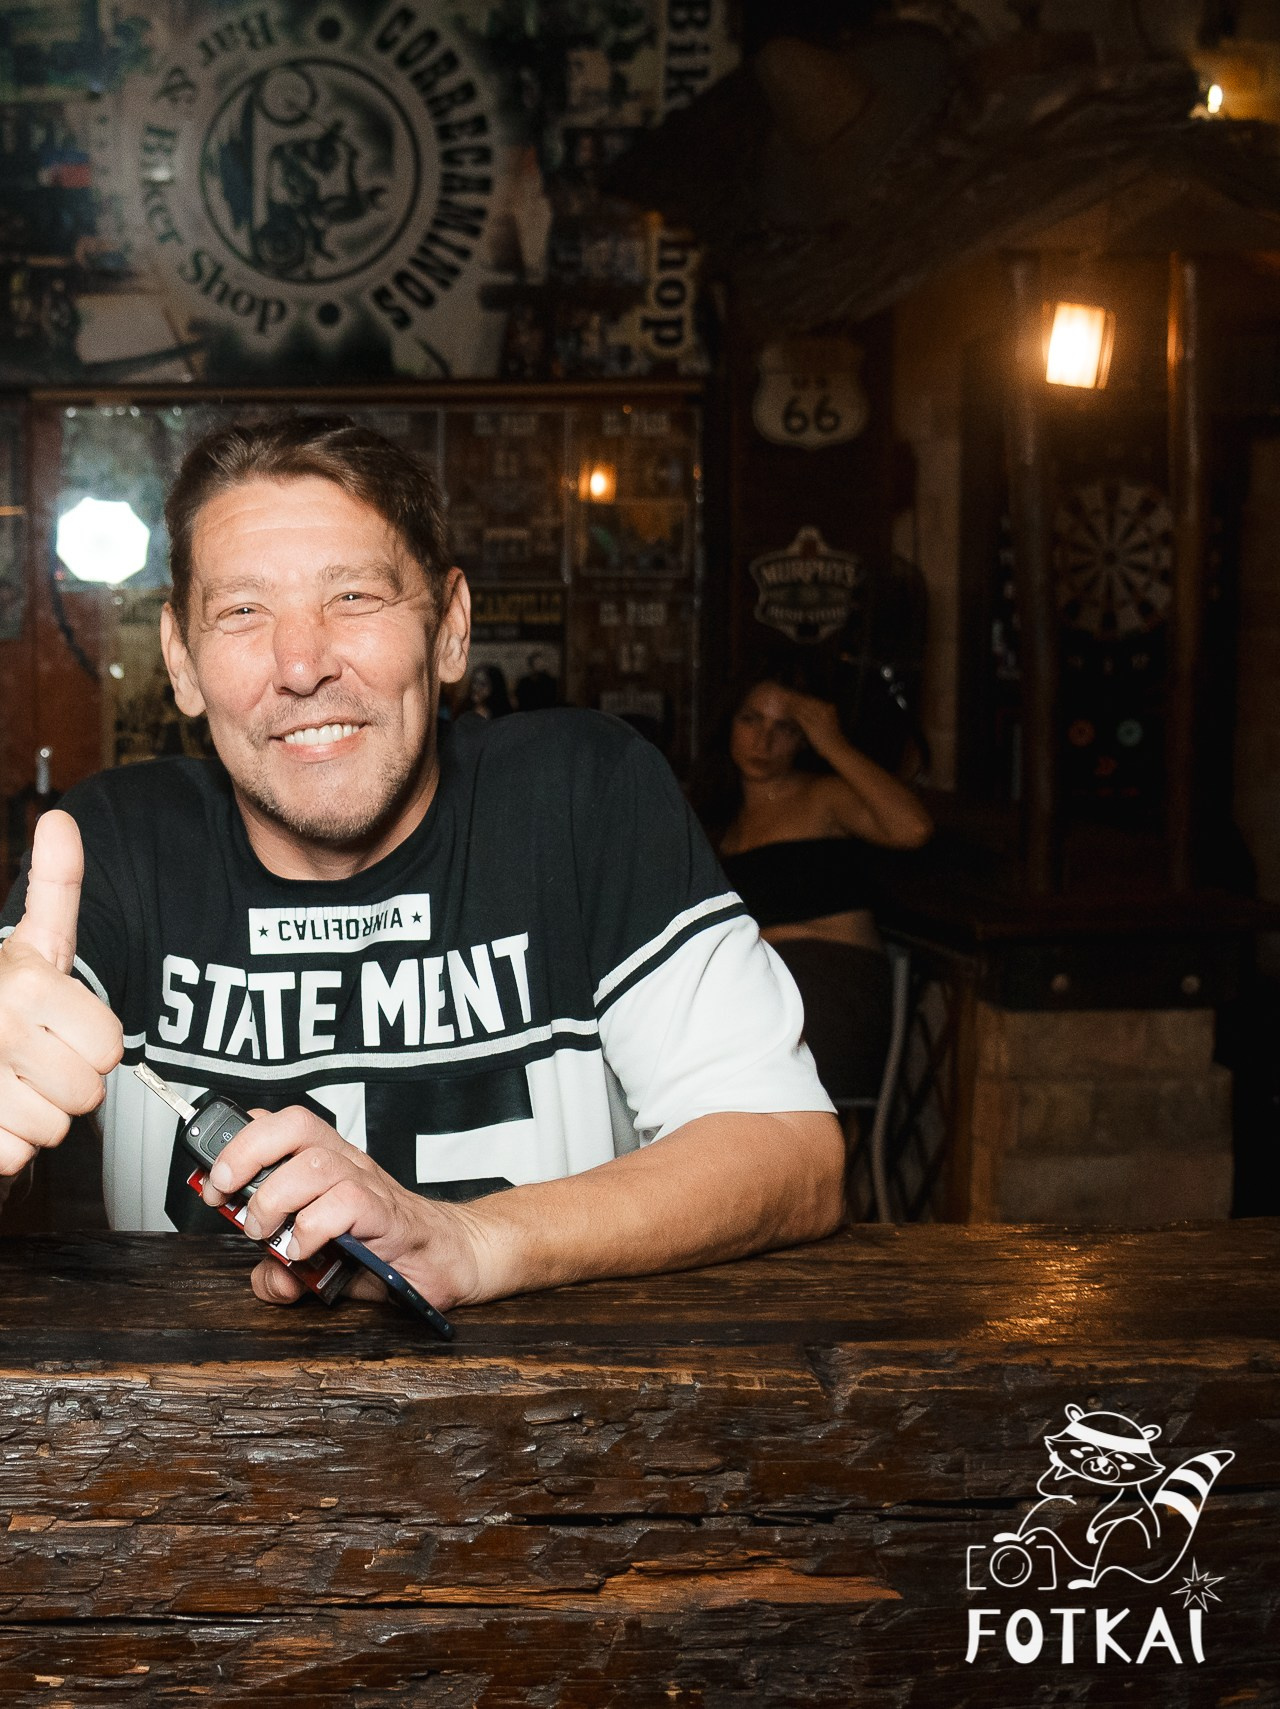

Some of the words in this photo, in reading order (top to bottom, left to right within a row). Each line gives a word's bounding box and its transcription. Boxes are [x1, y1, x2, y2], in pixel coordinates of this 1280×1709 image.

[177, 246, 288, 335] Shop
[641, 236, 700, 348] hop
[782, 395, 841, 435] 66
